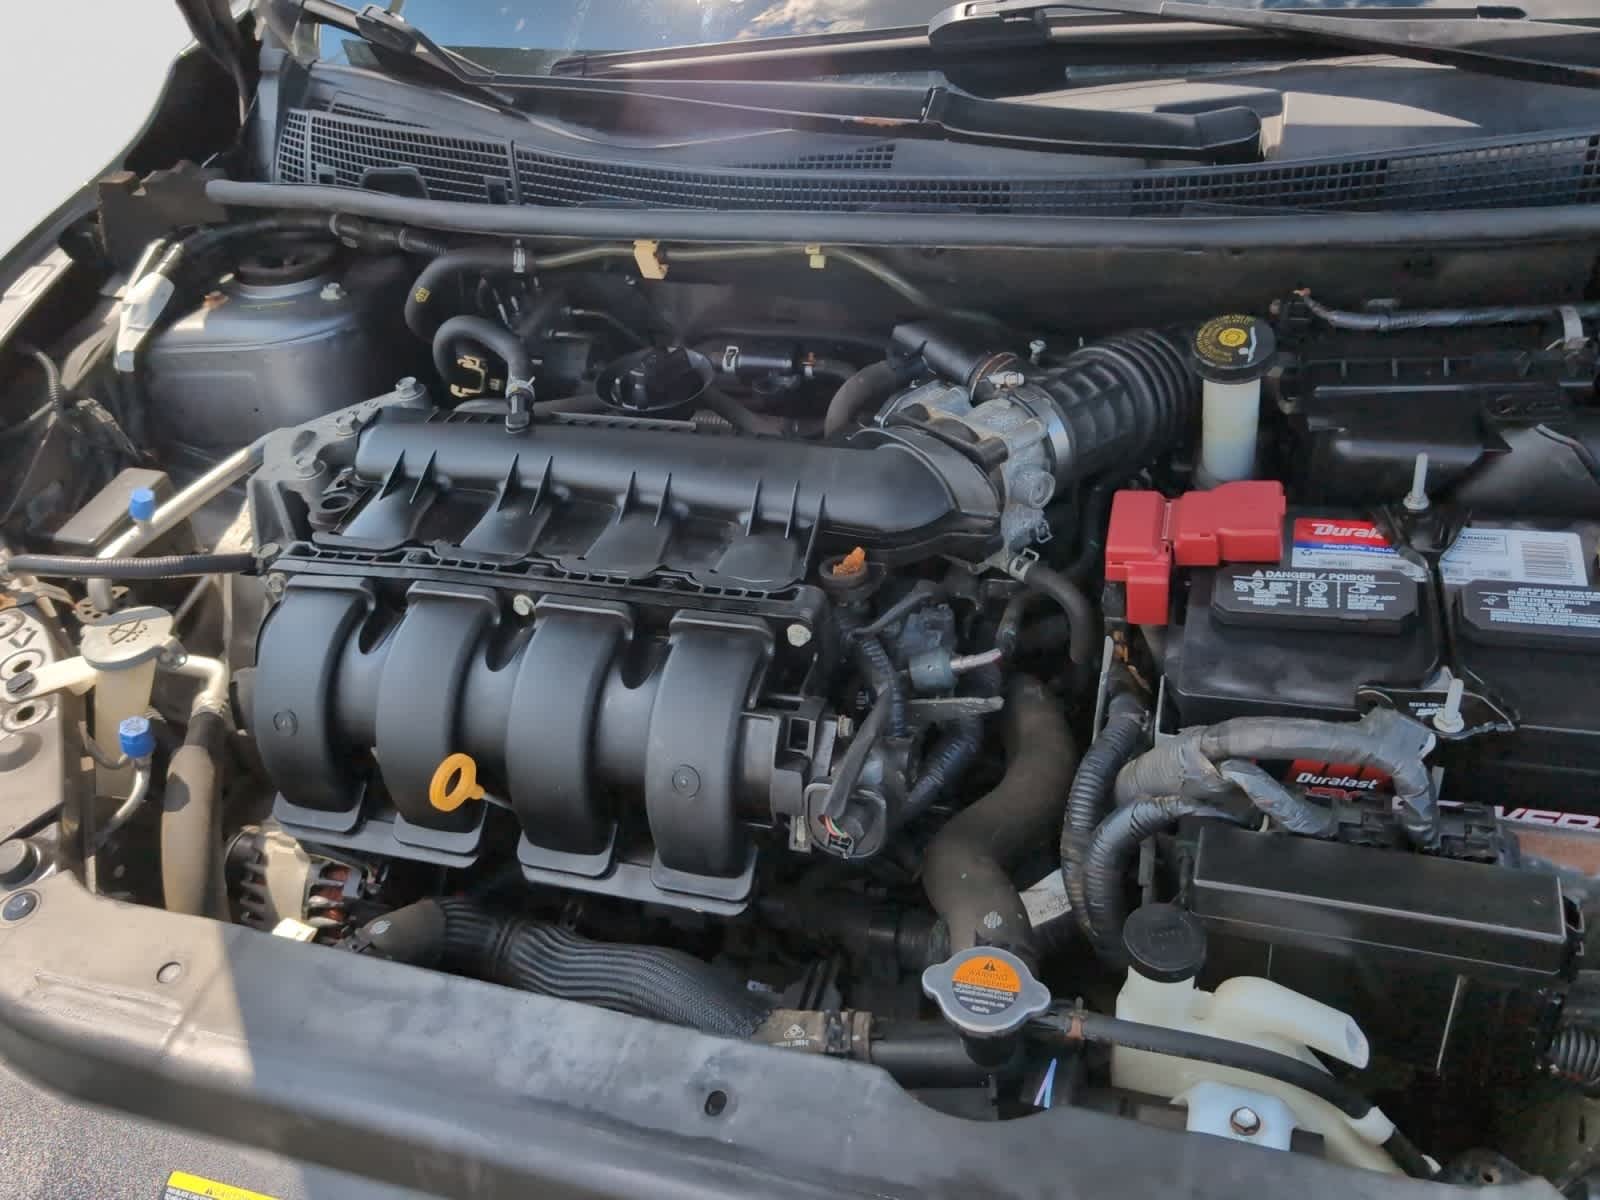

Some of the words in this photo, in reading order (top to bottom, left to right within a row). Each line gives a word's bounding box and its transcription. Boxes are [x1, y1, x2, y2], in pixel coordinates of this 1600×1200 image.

[1311, 523, 1384, 539] Dural
[1265, 571, 1315, 579] DANGER
[1329, 573, 1375, 582] POISON
[1296, 772, 1378, 789] Duralast
